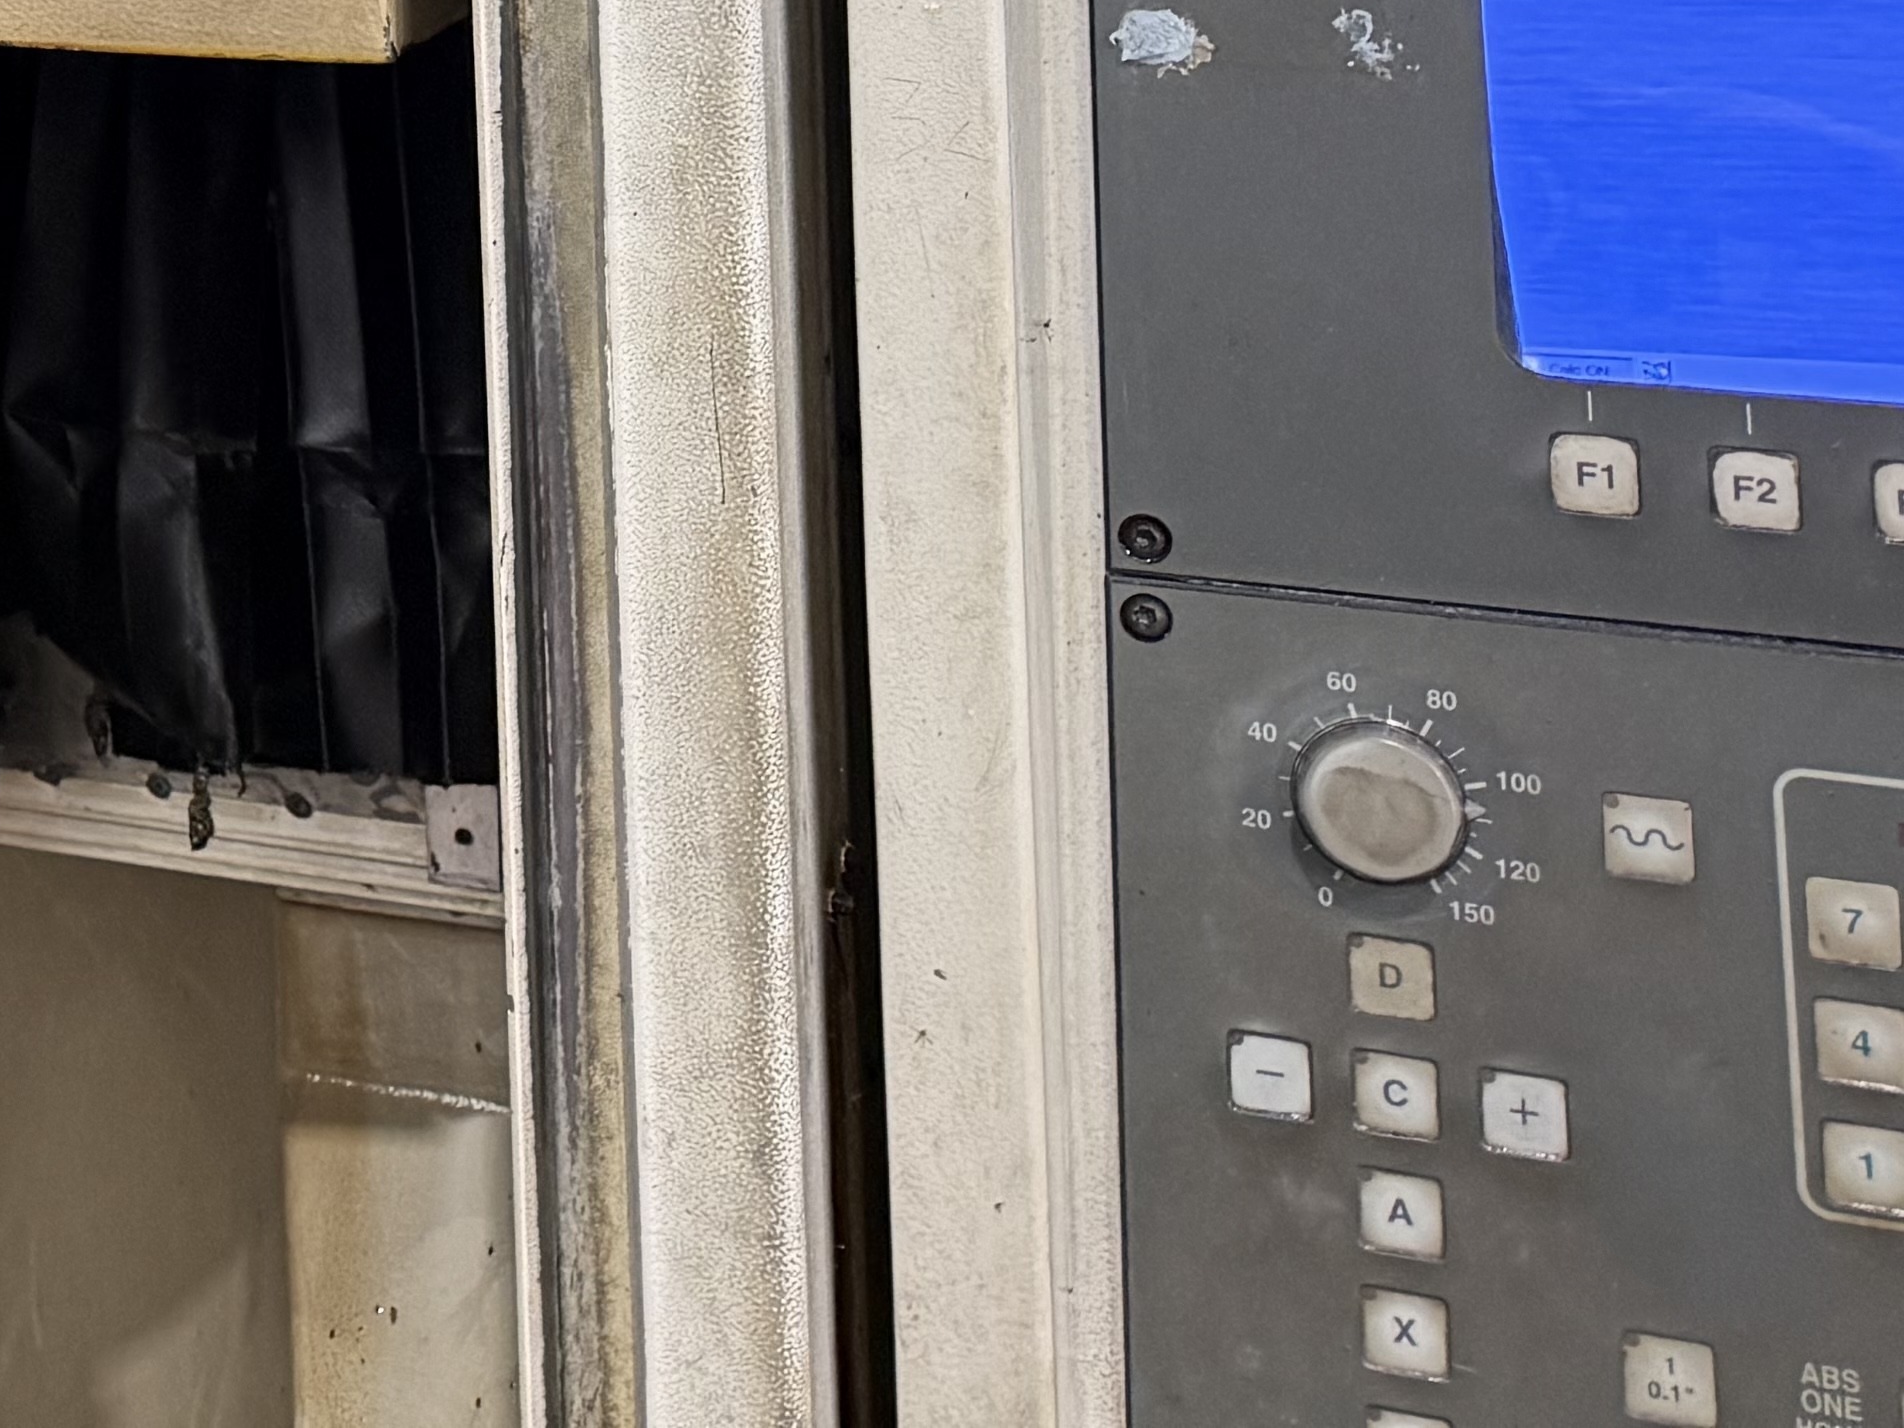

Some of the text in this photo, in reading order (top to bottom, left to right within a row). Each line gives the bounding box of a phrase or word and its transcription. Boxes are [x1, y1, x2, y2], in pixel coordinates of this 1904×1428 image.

[1577, 462, 1616, 491] F1
[1733, 475, 1777, 504] F2
[1326, 672, 1357, 693] 60
[1425, 690, 1458, 712] 80
[1247, 722, 1278, 743] 40
[1495, 772, 1542, 796] 100
[1241, 808, 1272, 830] 20
[1495, 860, 1541, 883] 120
[1318, 887, 1334, 908] 0
[1448, 902, 1495, 927] 150
[1842, 908, 1863, 934] 7
[1378, 962, 1402, 989] D
[1851, 1030, 1871, 1056] 4
[1383, 1079, 1409, 1108] C
[1859, 1152, 1873, 1181] 1
[1388, 1198, 1413, 1227] A
[1392, 1316, 1416, 1346] X
[1665, 1357, 1674, 1375] 1
[1800, 1362, 1861, 1393] ABS
[1800, 1389, 1864, 1422] ONE
